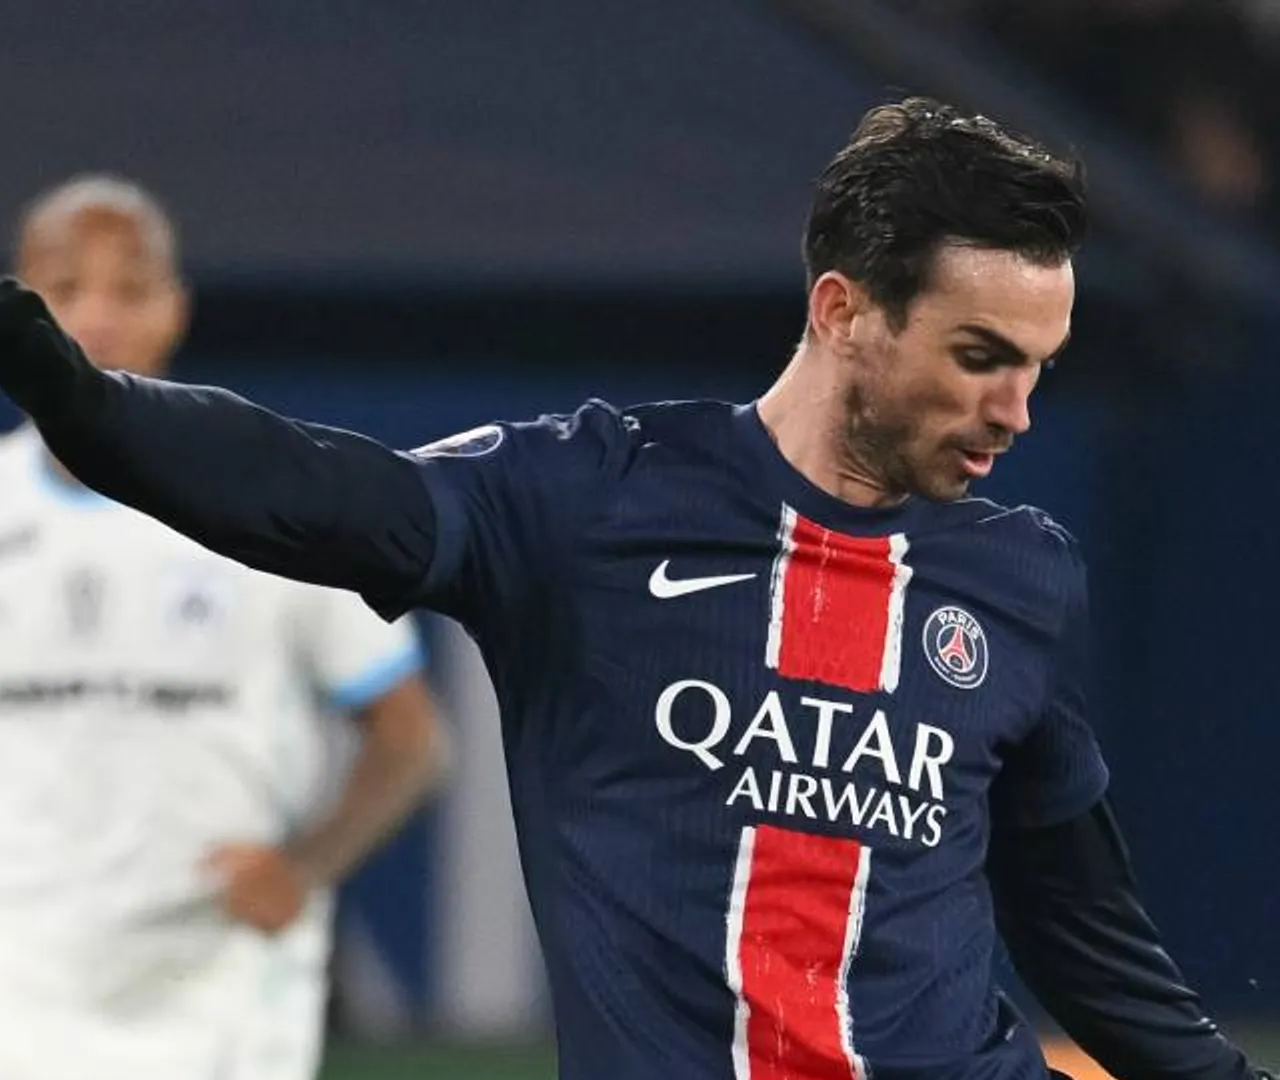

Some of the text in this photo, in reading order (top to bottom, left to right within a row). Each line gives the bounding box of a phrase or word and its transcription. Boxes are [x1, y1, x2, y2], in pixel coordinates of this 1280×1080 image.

[938, 611, 981, 641] PARIS
[655, 679, 954, 800] QATAR
[725, 766, 947, 848] AIRWAYS
